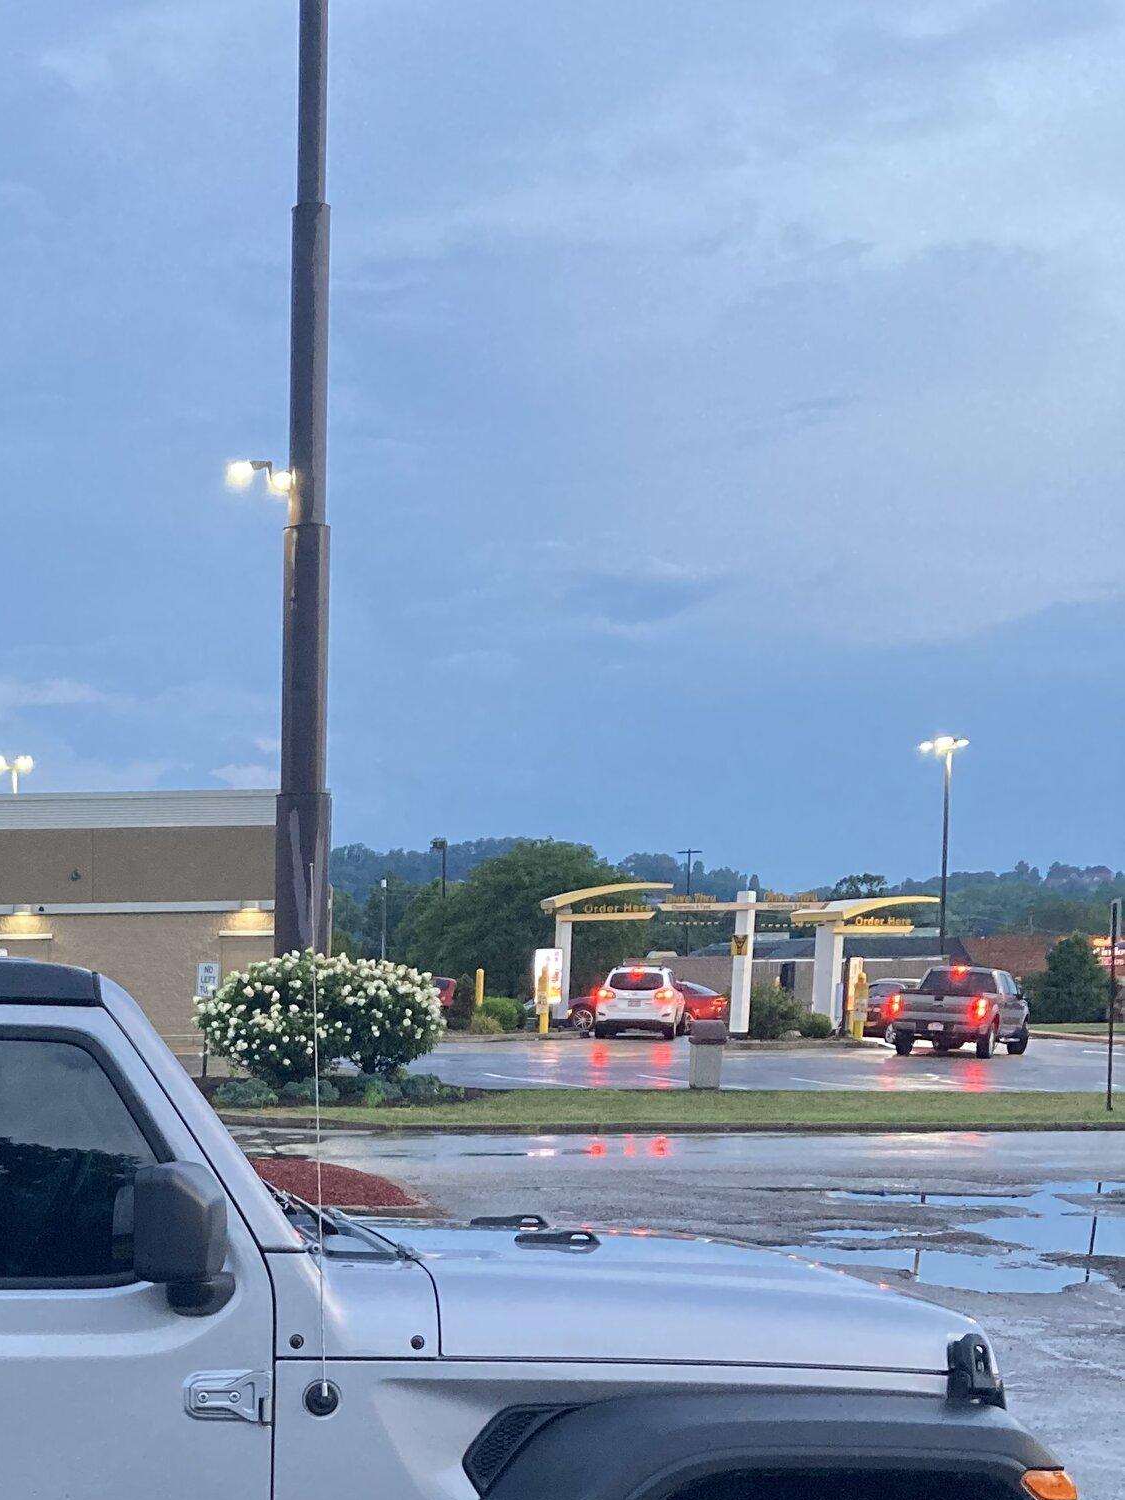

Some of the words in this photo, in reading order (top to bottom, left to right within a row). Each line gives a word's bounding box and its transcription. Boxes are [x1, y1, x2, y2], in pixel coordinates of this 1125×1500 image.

[584, 904, 618, 914] Order
[624, 903, 652, 912] Here
[855, 917, 885, 926] Order
[888, 916, 912, 926] Here
[204, 966, 214, 974] NO
[200, 975, 216, 984] LEFT
